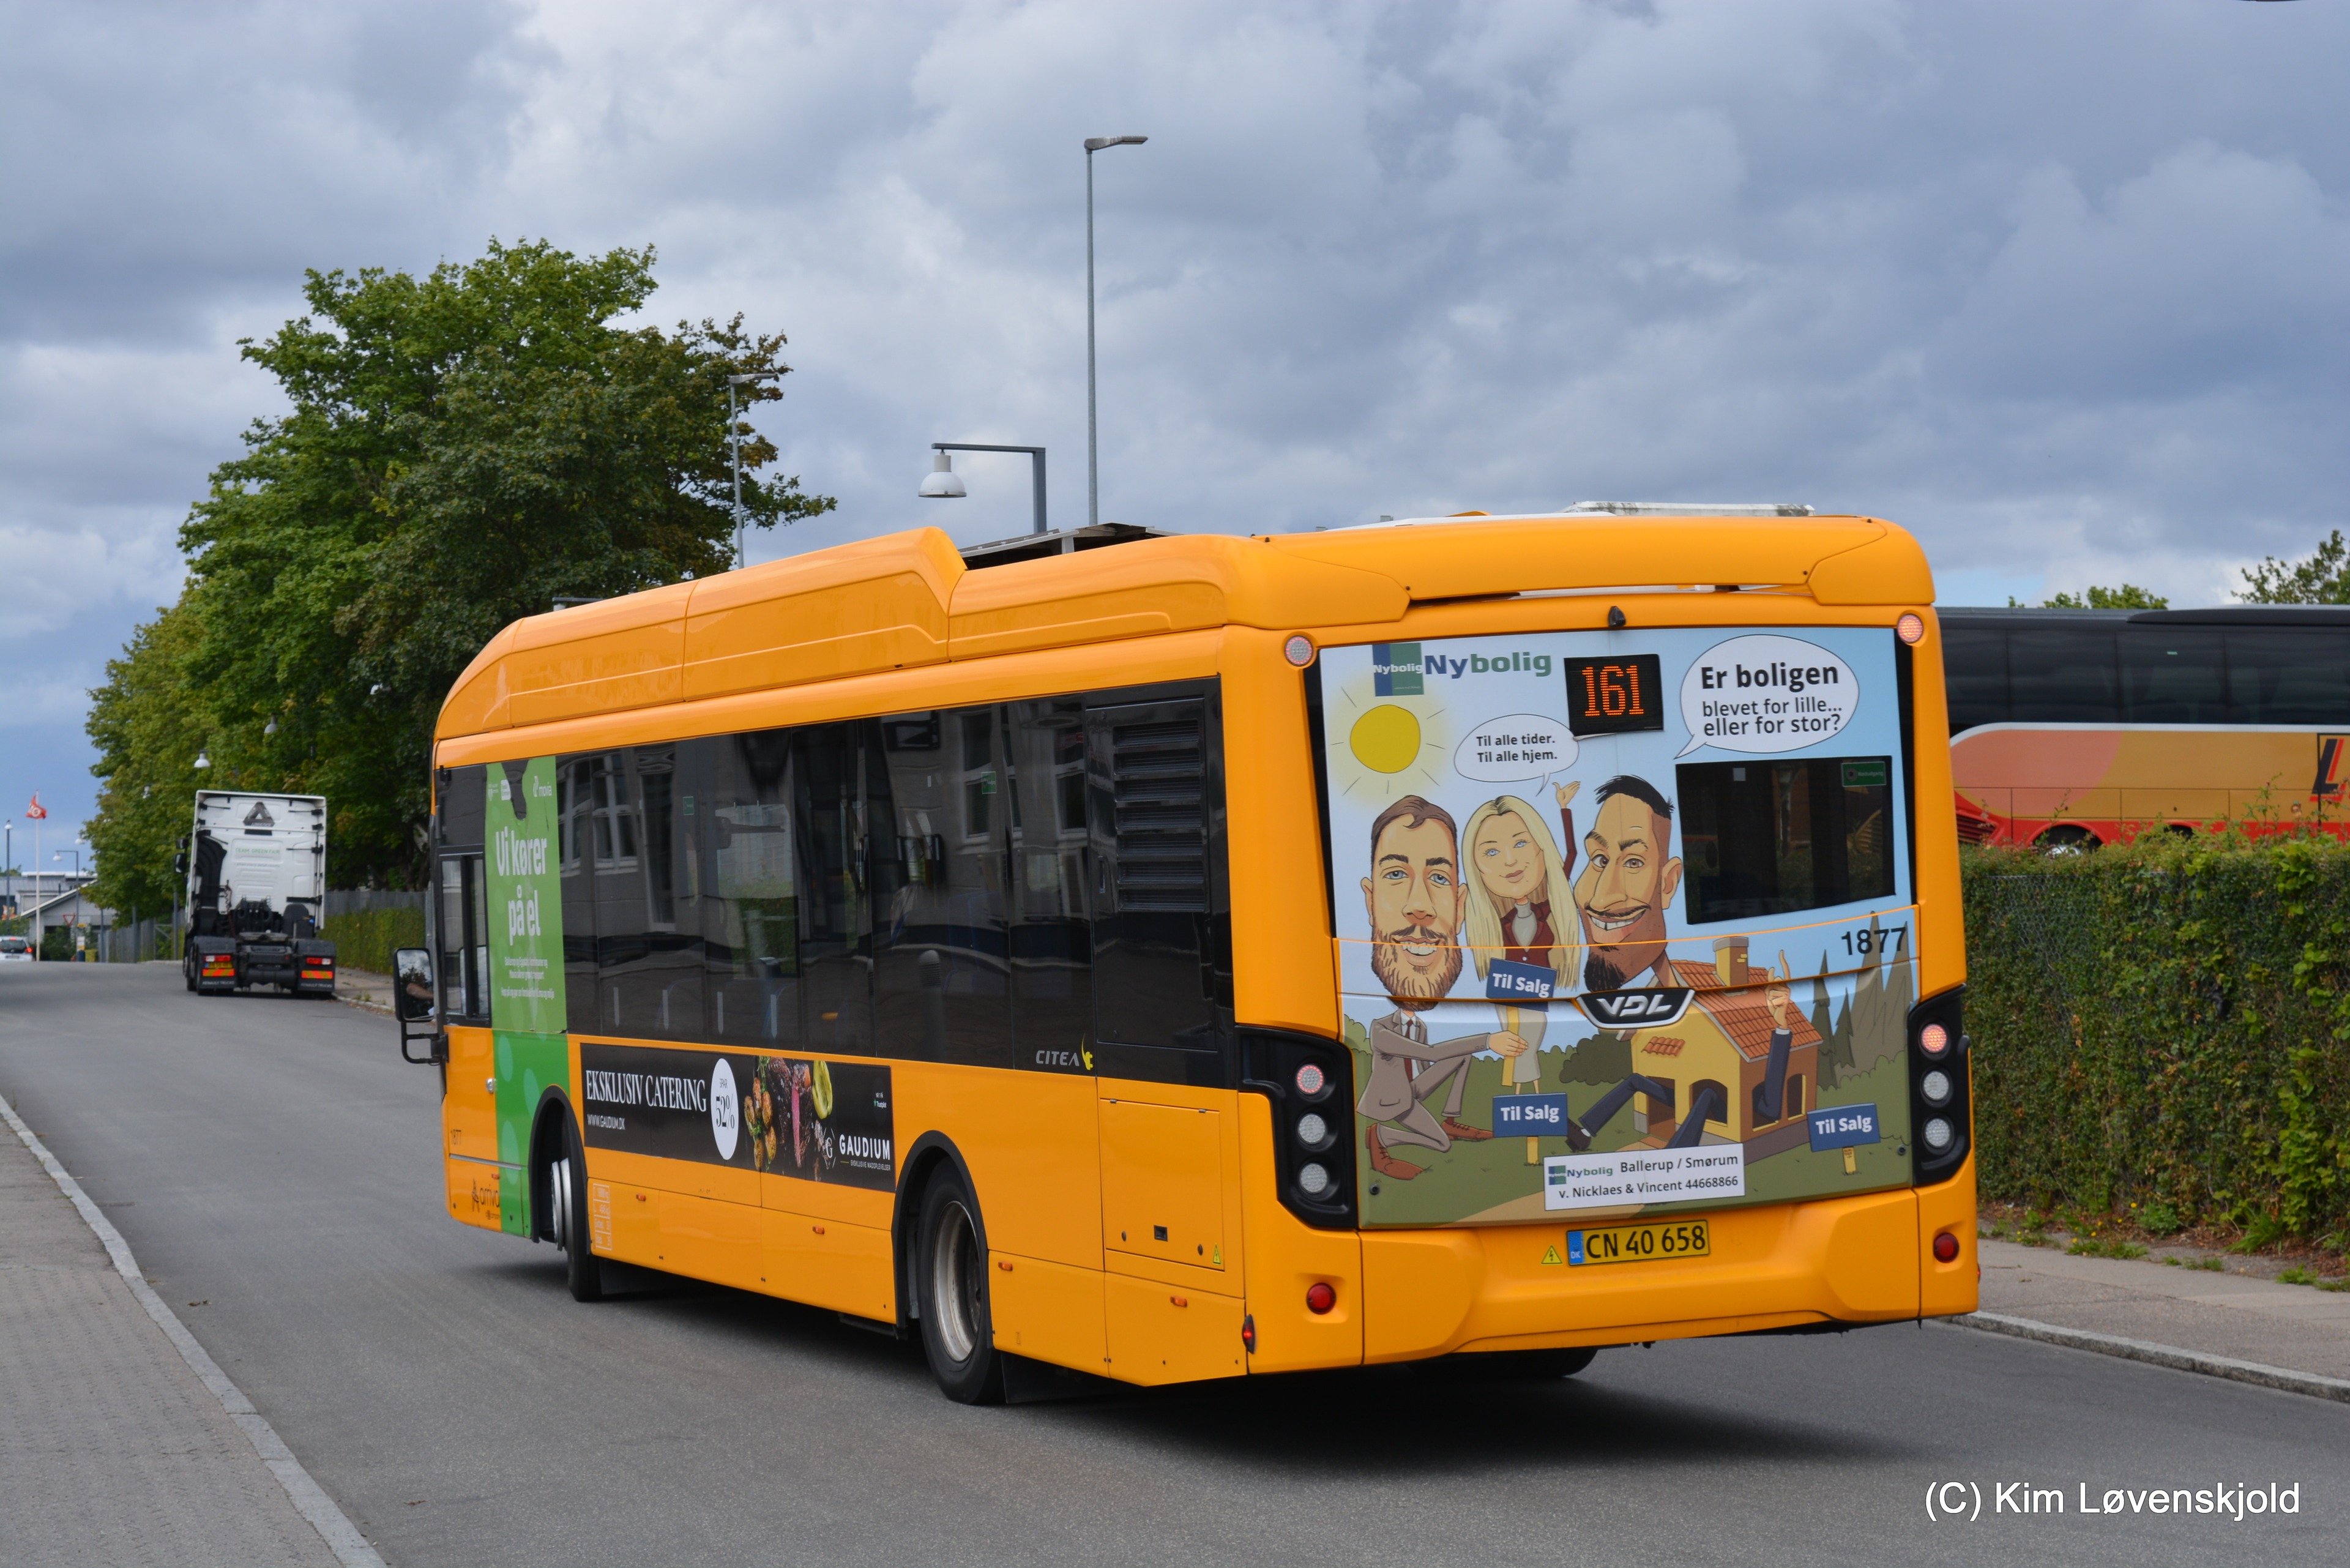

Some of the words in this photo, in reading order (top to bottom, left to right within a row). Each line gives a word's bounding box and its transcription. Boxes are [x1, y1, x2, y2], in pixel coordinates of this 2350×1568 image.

[1373, 663, 1423, 675] Nybolig
[1424, 651, 1552, 679] Nybolig
[1701, 666, 1727, 689] Er
[1736, 662, 1839, 692] boligen
[1581, 665, 1645, 717] 161
[1703, 701, 1758, 717] blevet
[1763, 698, 1789, 714] for
[1795, 696, 1842, 713] lille...
[1704, 717, 1748, 736] eller
[1755, 716, 1784, 734] for
[1791, 714, 1841, 733] stor?
[1476, 736, 1491, 746] Til
[1495, 734, 1518, 745] alle
[1521, 733, 1555, 744] tider.
[1477, 752, 1492, 763] Til
[1496, 751, 1518, 761] alle
[1522, 750, 1557, 763] hjem.
[496, 826, 510, 876] Vi
[511, 830, 547, 875] kører
[508, 884, 524, 946] på
[527, 890, 541, 936] el
[1841, 927, 1906, 955] 1877
[1493, 973, 1512, 989] Til
[1515, 977, 1551, 998] Salg
[1596, 994, 1672, 1017] VDL
[1036, 1050, 1080, 1066] CITEA
[586, 1070, 643, 1105] EKSKLUSIV
[645, 1075, 707, 1112] CATERING
[719, 1078, 728, 1089] SPAR
[587, 1114, 625, 1130] WWW.GAUDIUM.DK
[715, 1092, 735, 1130] 52%
[1501, 1106, 1521, 1121] Til
[1524, 1105, 1559, 1123] Salg
[1815, 1119, 1835, 1135] Til
[1838, 1115, 1872, 1132] Salg
[839, 1134, 890, 1160] GAUDIUM
[1567, 1167, 1613, 1178] Nybolig
[1621, 1160, 1674, 1173] Ballerup
[1685, 1155, 1738, 1168] Smørum
[1572, 1185, 1622, 1198] Nicklaes
[1625, 1184, 1635, 1194] &
[1636, 1180, 1682, 1193] Vincent
[1685, 1176, 1739, 1189] 44668866
[1586, 1233, 1619, 1259] CN
[1625, 1230, 1654, 1255] 40
[1662, 1225, 1706, 1253] 658
[1570, 1251, 1581, 1260] DK
